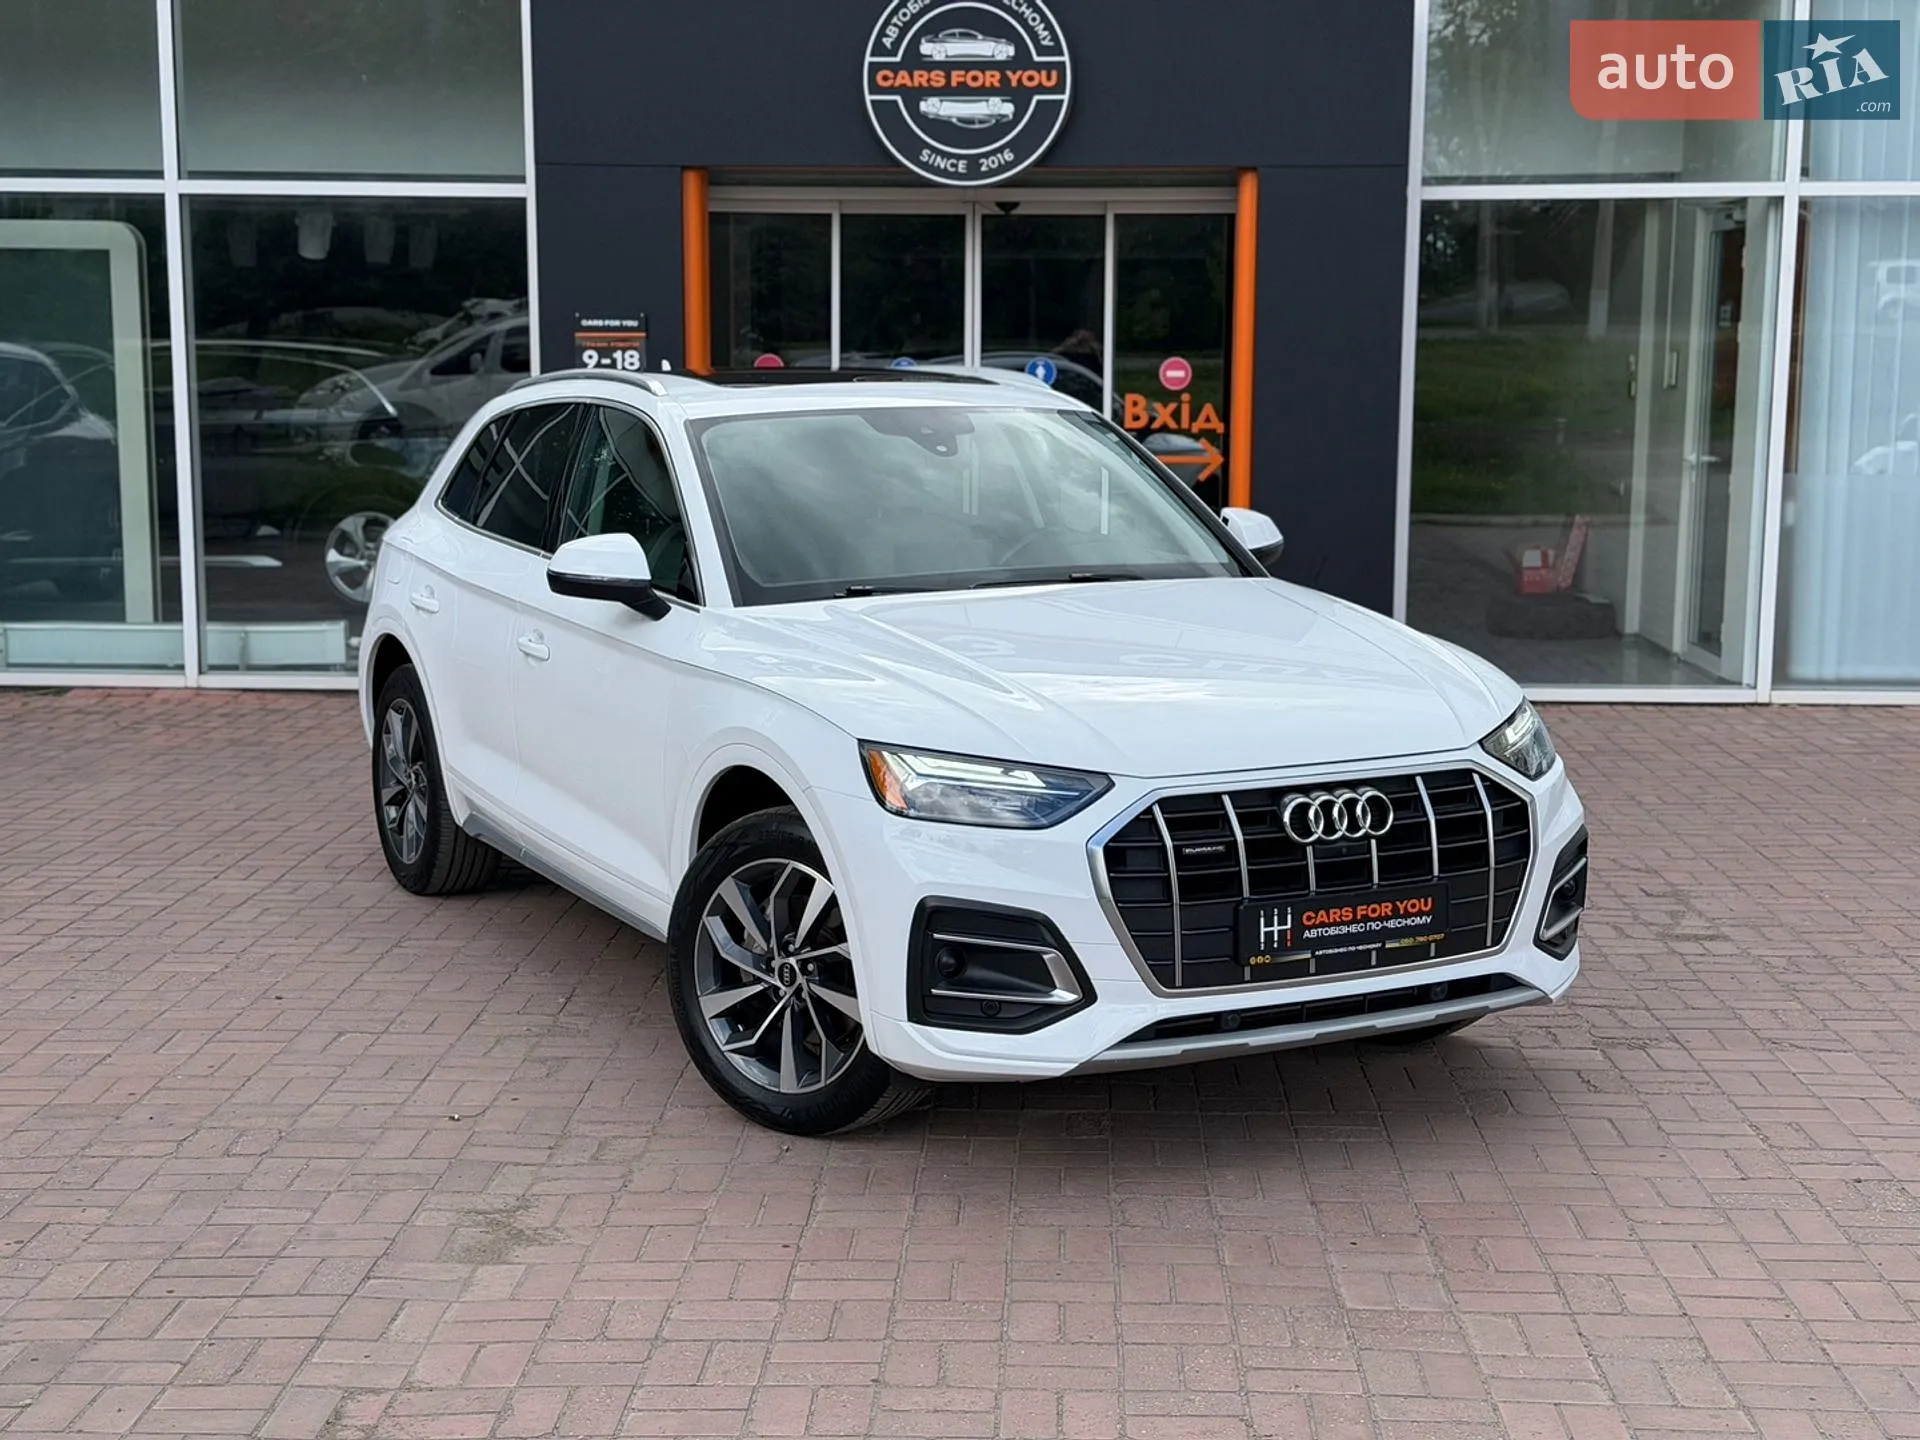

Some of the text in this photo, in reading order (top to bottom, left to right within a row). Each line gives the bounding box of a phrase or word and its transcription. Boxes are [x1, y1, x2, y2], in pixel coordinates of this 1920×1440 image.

[875, 69, 1058, 88] CARS FOR YOU
[918, 148, 1015, 173] SINCE 2016
[604, 319, 620, 327] FOR
[621, 319, 639, 327] YOU
[582, 349, 640, 370] 9-18
[1123, 392, 1225, 434] Вхід
[1302, 896, 1433, 926] CARS FOR YOU
[1302, 915, 1433, 939] АВТОБІЗНЕС ПО-ЧЕСНОМУ
